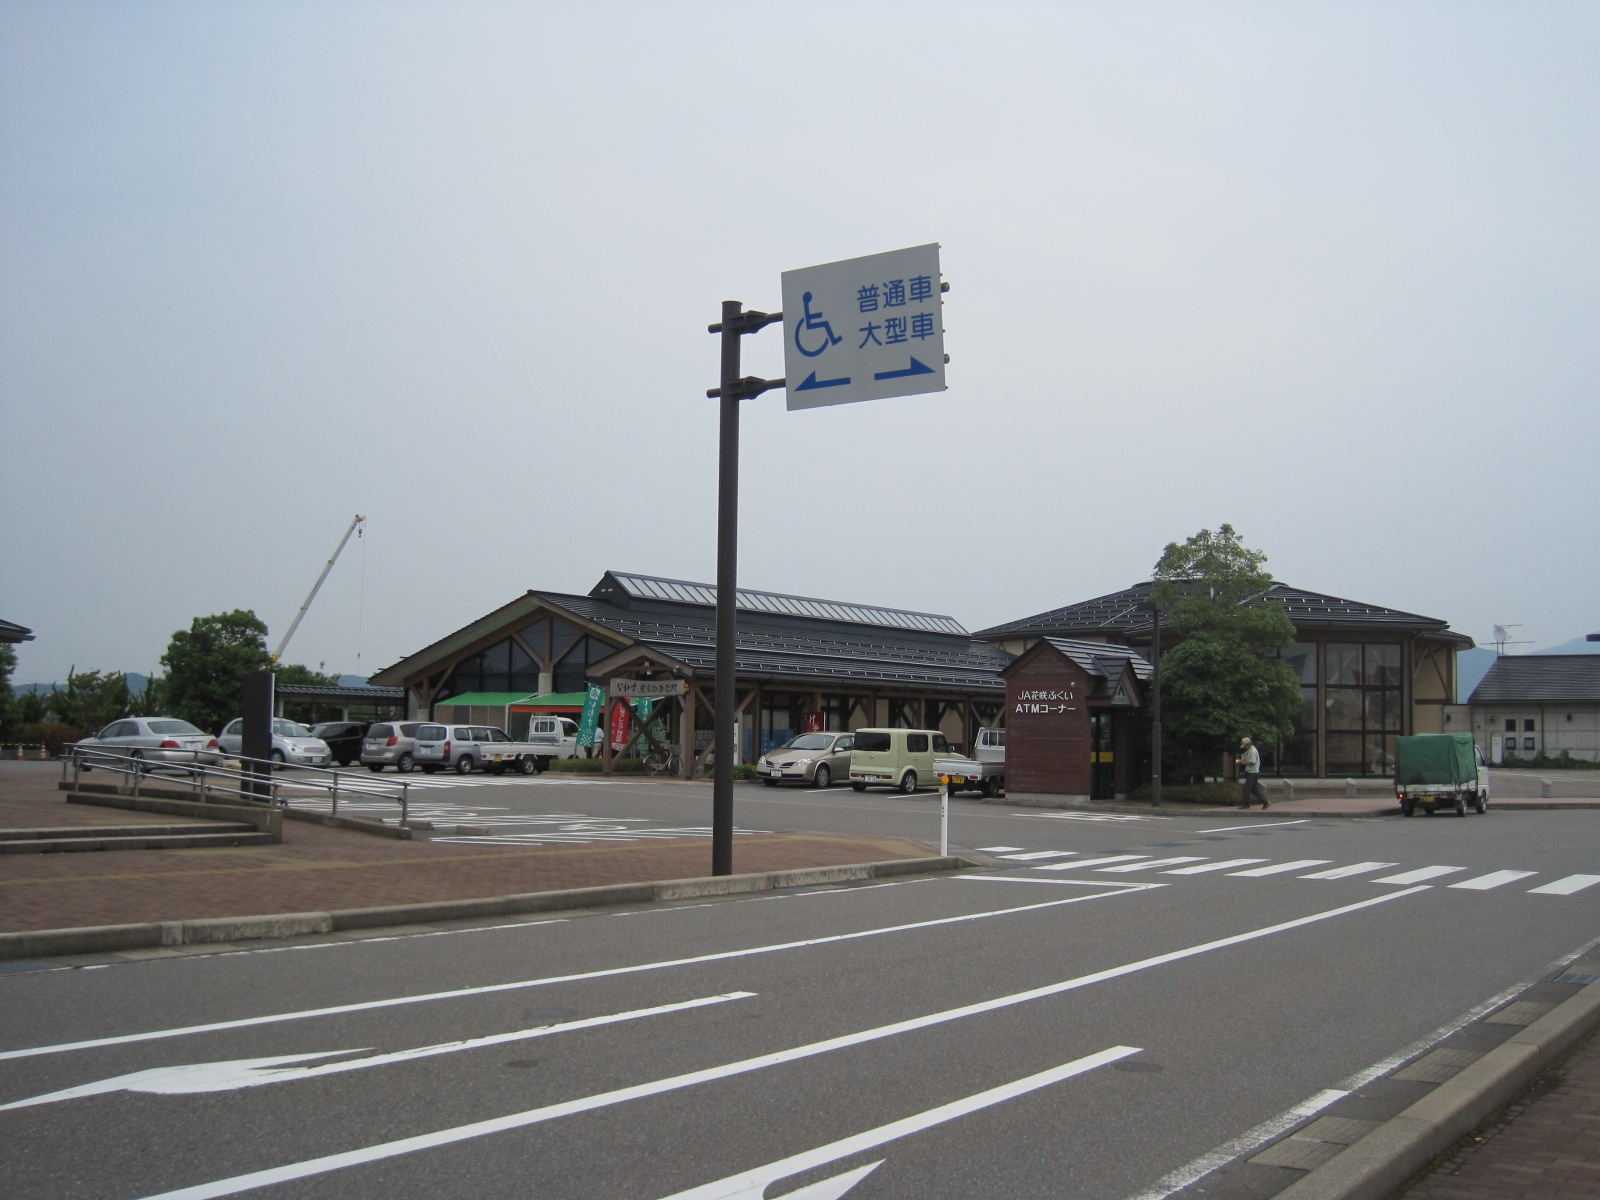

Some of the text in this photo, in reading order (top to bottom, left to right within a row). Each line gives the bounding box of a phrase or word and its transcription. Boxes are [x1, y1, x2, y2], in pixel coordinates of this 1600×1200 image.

[857, 274, 933, 312] 普通車
[859, 312, 935, 349] 大型車
[1018, 690, 1073, 701] JA花咲ふくい
[1015, 703, 1075, 714] ATMコーナー
